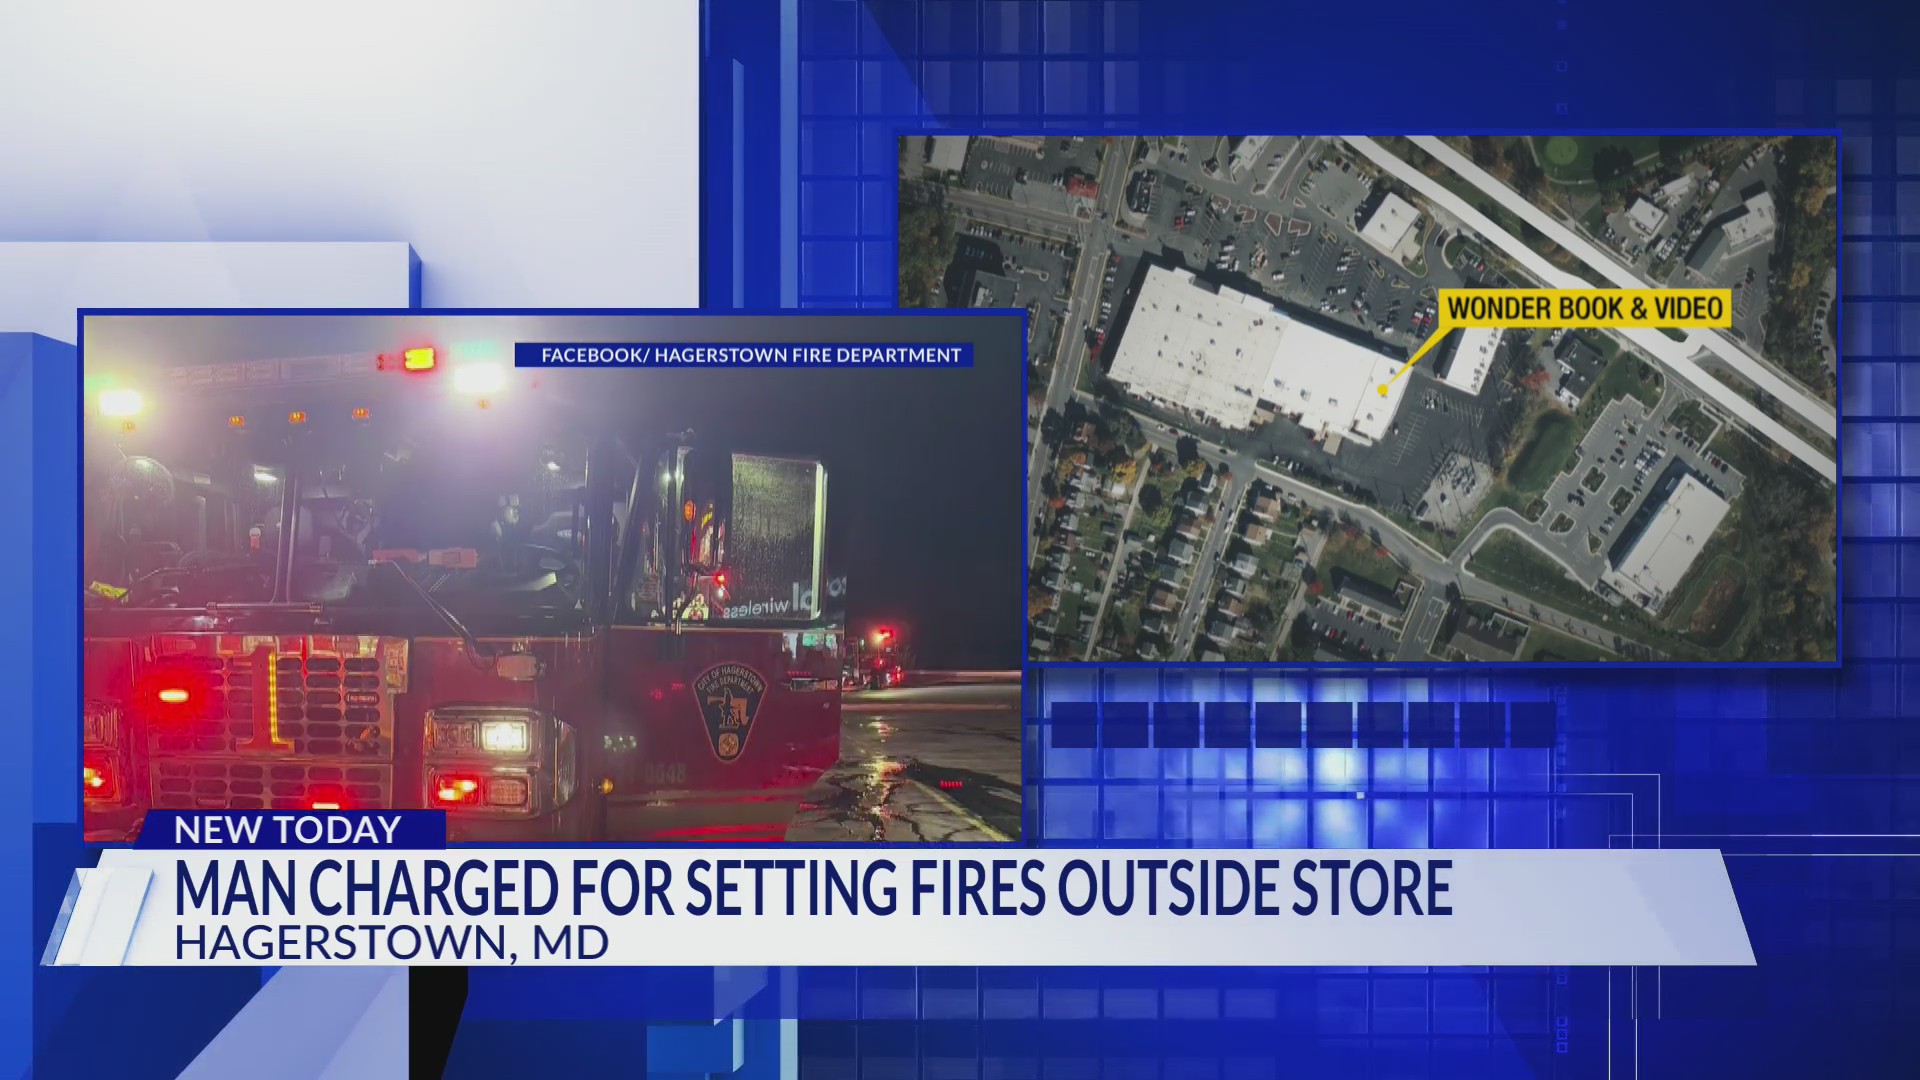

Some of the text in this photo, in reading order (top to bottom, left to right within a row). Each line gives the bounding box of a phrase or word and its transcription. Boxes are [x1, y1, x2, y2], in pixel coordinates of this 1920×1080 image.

[697, 665, 763, 692] CITY OF HAGERSTOWN
[706, 676, 754, 694] FIRE DEPARTMENT
